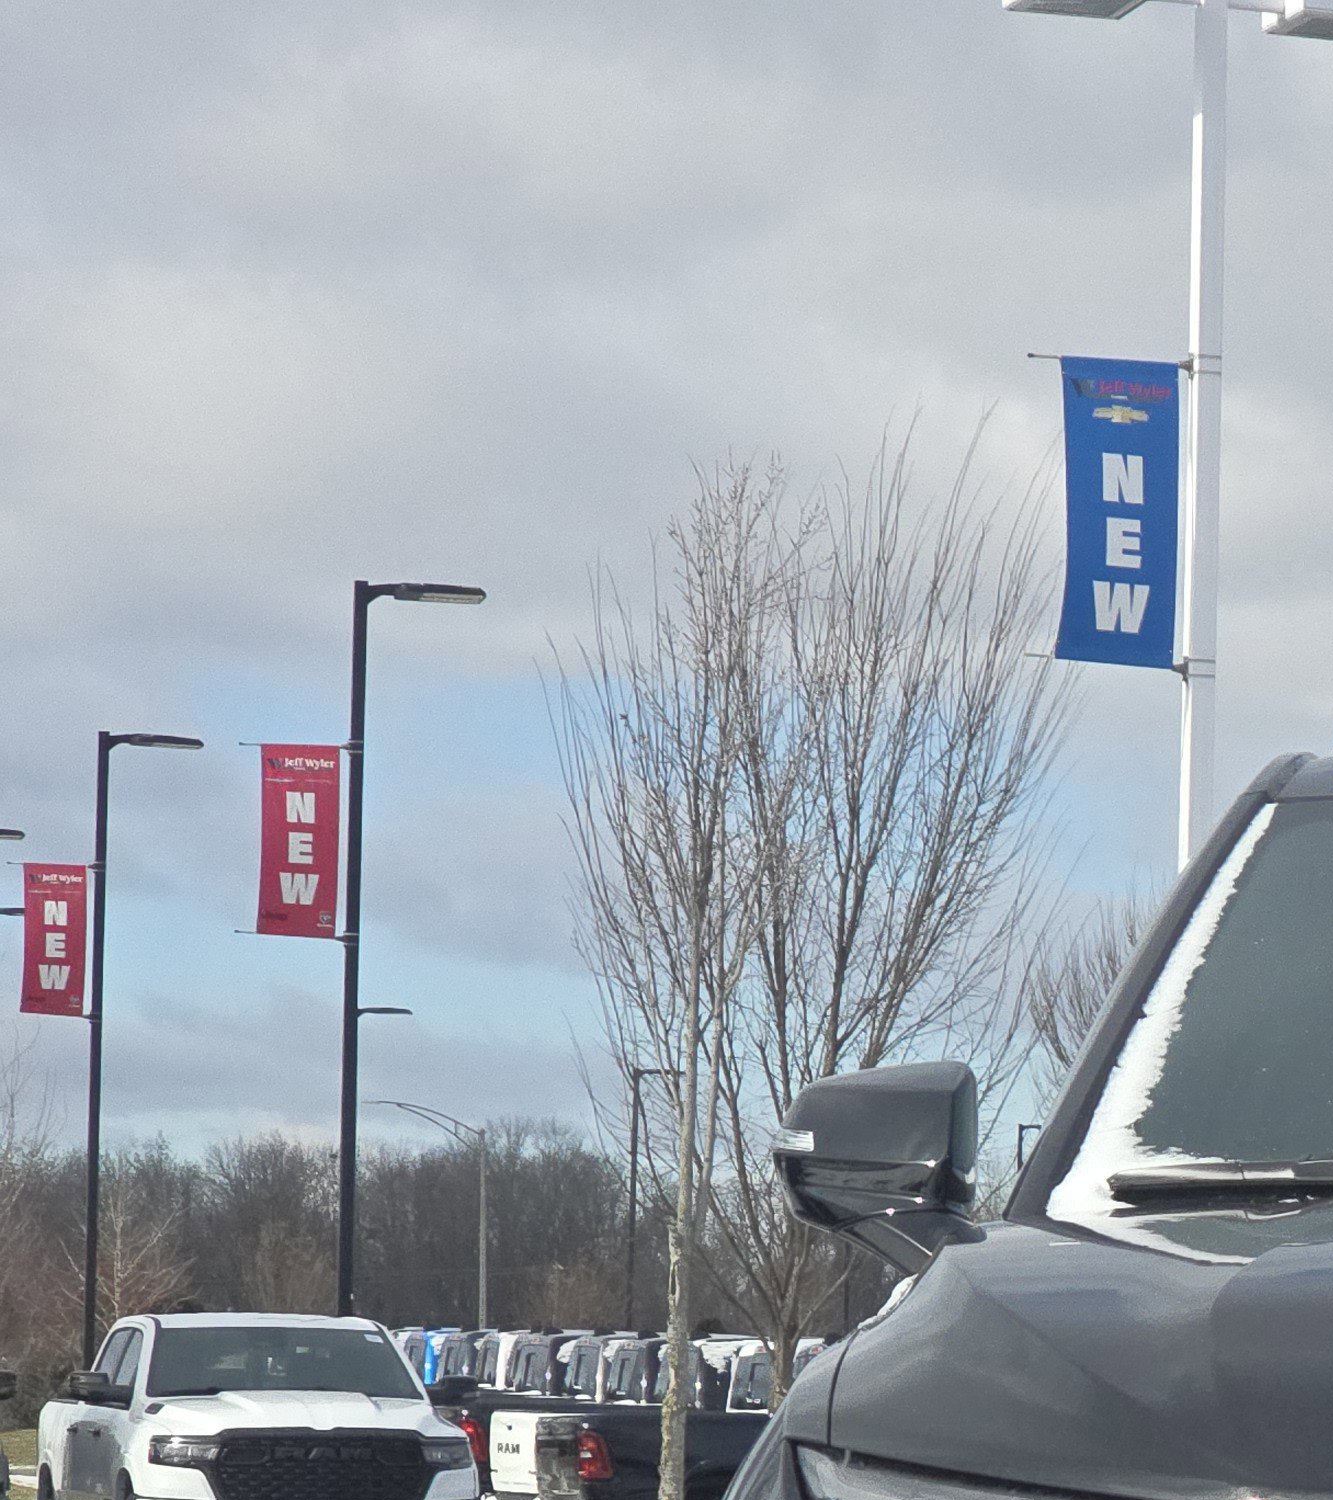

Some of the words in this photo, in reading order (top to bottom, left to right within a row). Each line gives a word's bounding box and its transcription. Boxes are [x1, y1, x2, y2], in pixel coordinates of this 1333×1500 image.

[1093, 452, 1150, 634] NEW
[284, 757, 304, 768] Jeff
[305, 758, 336, 771] Wyler
[279, 790, 320, 906] NEW
[38, 900, 70, 990] NEW
[497, 1442, 520, 1454] RAM
